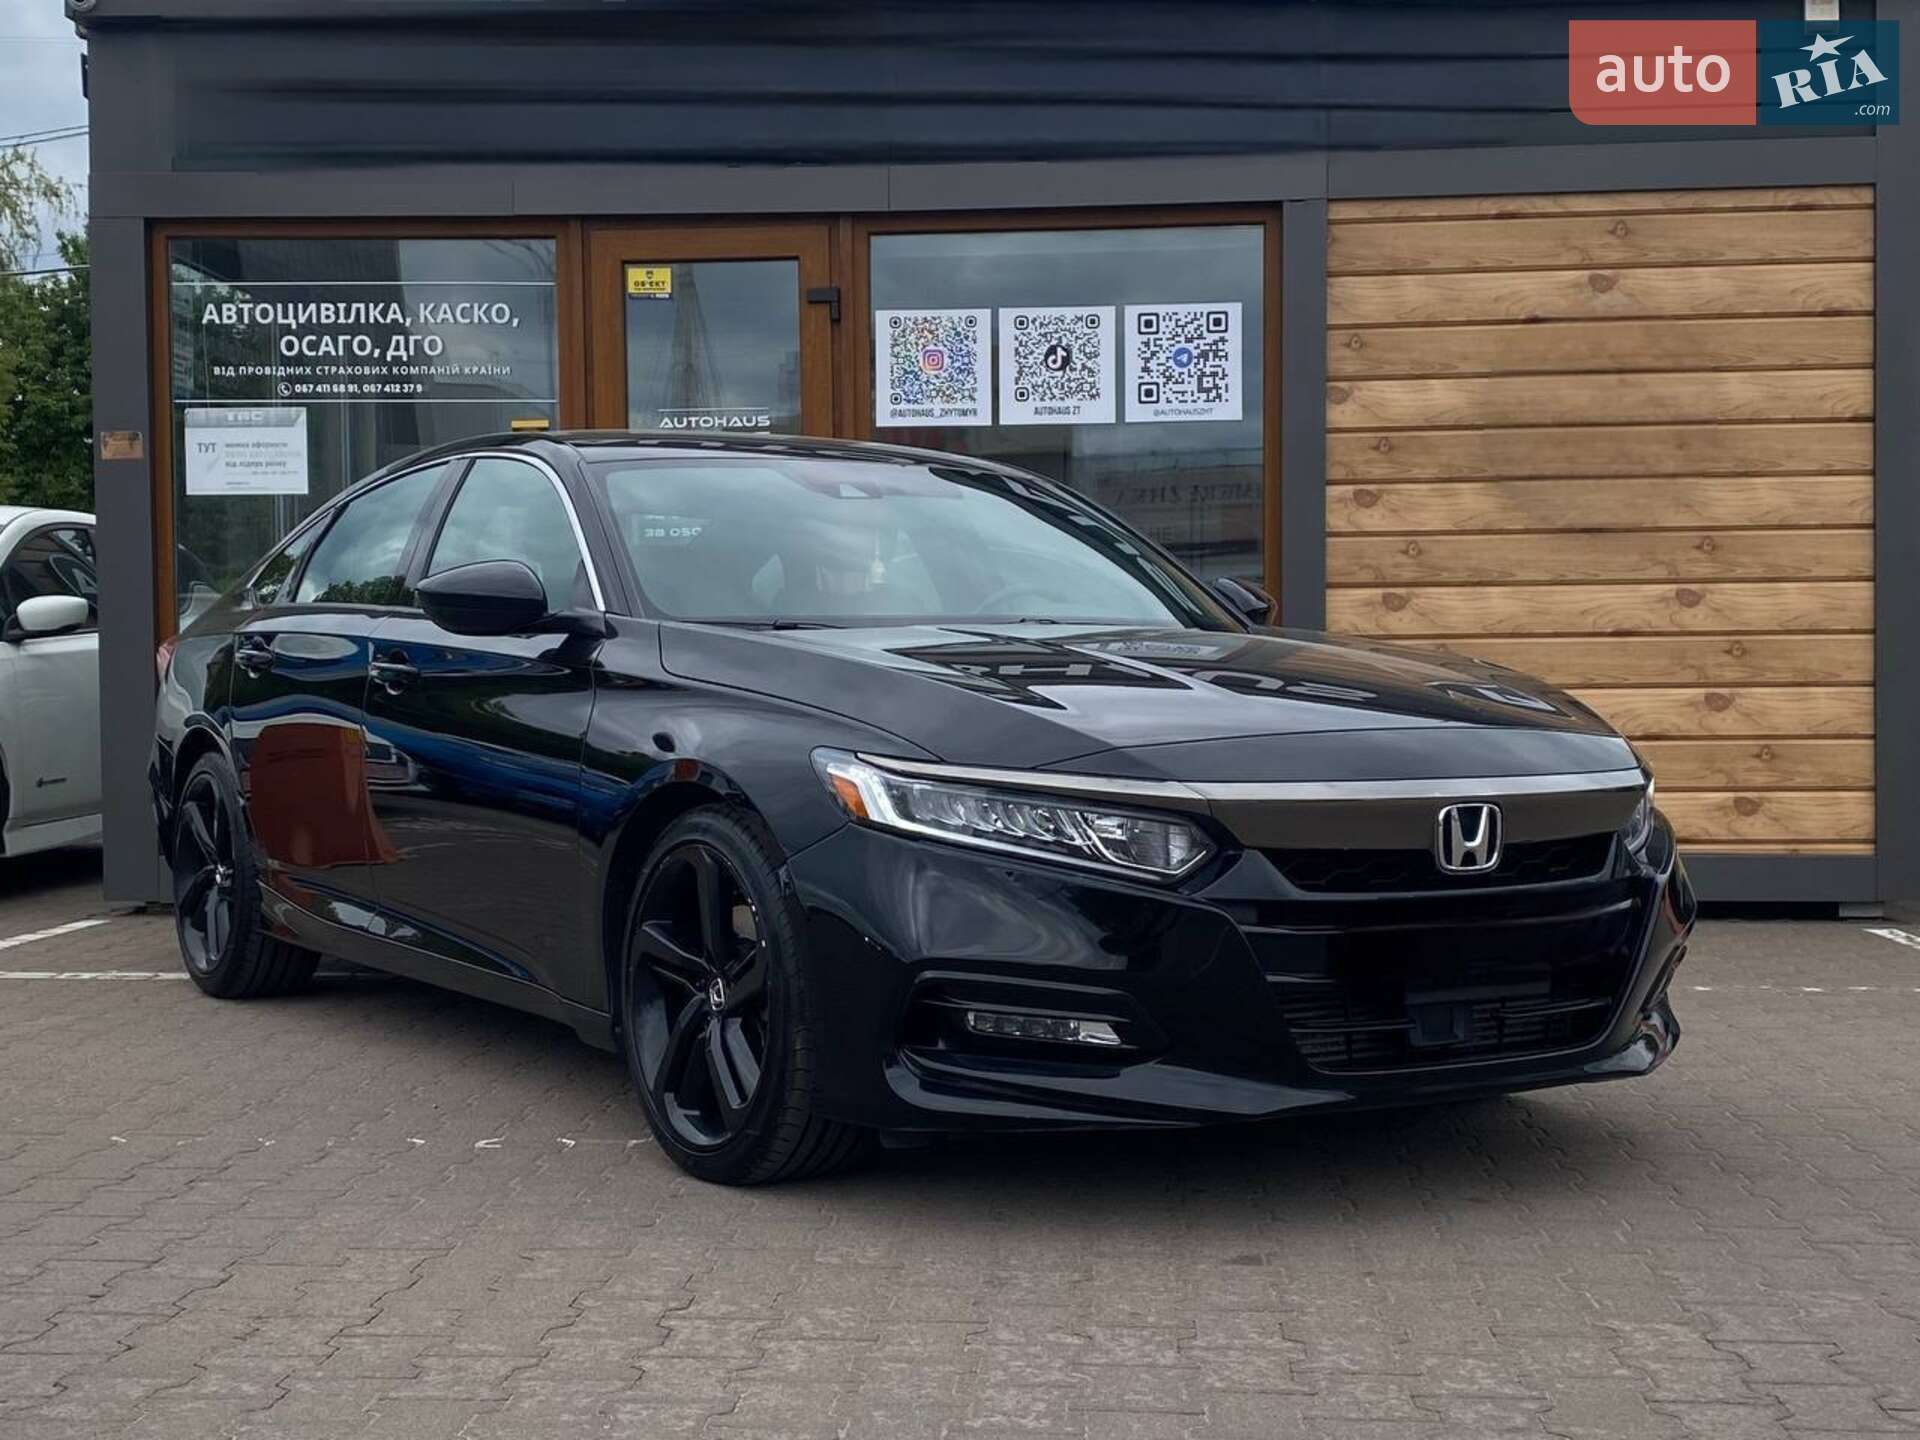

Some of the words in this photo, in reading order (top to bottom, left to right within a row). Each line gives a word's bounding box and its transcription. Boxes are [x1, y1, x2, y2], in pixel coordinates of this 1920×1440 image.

[202, 302, 412, 329] АВТОЦИВІЛКА,
[419, 302, 520, 328] КАСКО,
[280, 335, 380, 358] ОСАГО,
[386, 335, 444, 361] ДГО
[213, 366, 235, 377] ВІД
[239, 366, 312, 377] ПРОВІДНИХ
[316, 365, 388, 376] СТРАХОВИХ
[392, 364, 460, 376] КОМПАНІЙ
[464, 363, 512, 376] КРАЇНИ
[384, 383, 401, 393] 412
[1033, 406, 1071, 416] AUTOHAUS
[658, 415, 770, 429] AUTOHAUS
[197, 443, 217, 454] ТУТ
